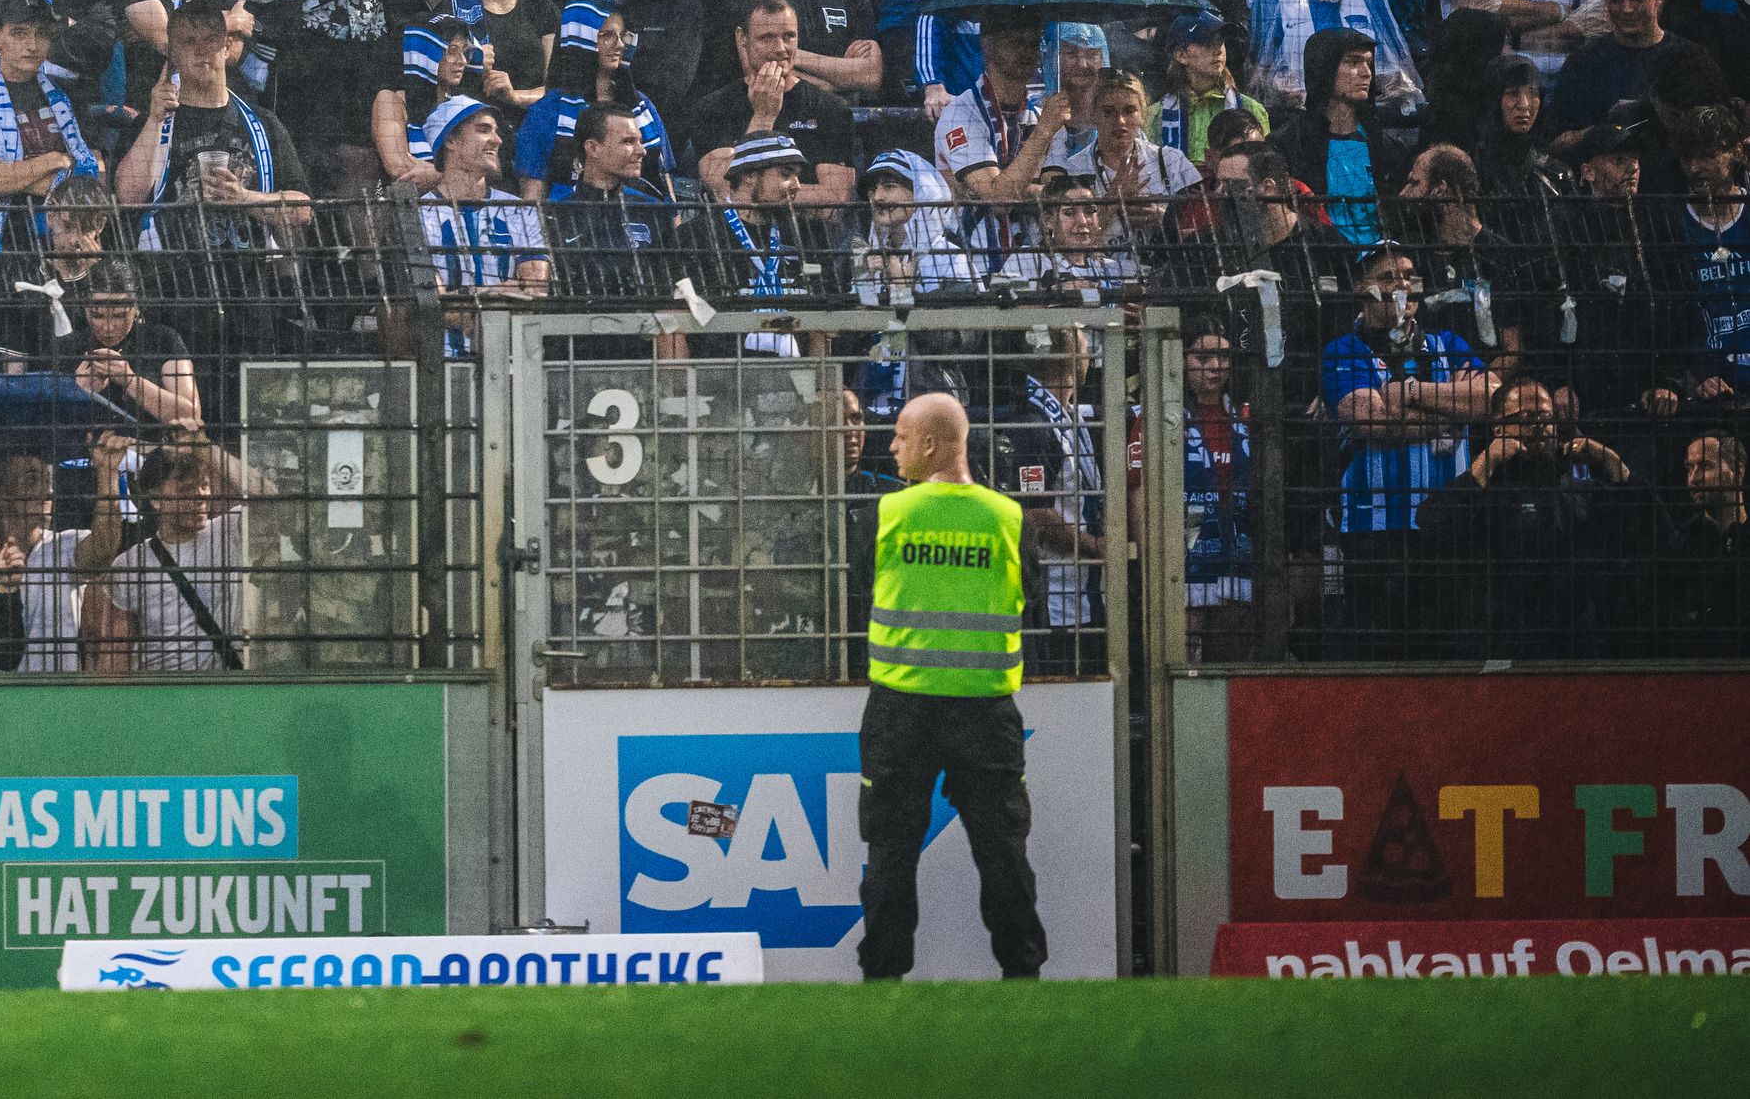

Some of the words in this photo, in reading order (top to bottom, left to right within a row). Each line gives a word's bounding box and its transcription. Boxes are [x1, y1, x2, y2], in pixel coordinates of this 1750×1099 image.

[585, 388, 644, 486] 3
[902, 542, 991, 570] ORDNER
[73, 789, 170, 848] MIT
[183, 788, 285, 847] UNS
[17, 876, 118, 935] HAT
[130, 874, 372, 935] ZUKUNFT
[1265, 939, 1536, 978] nahkauf
